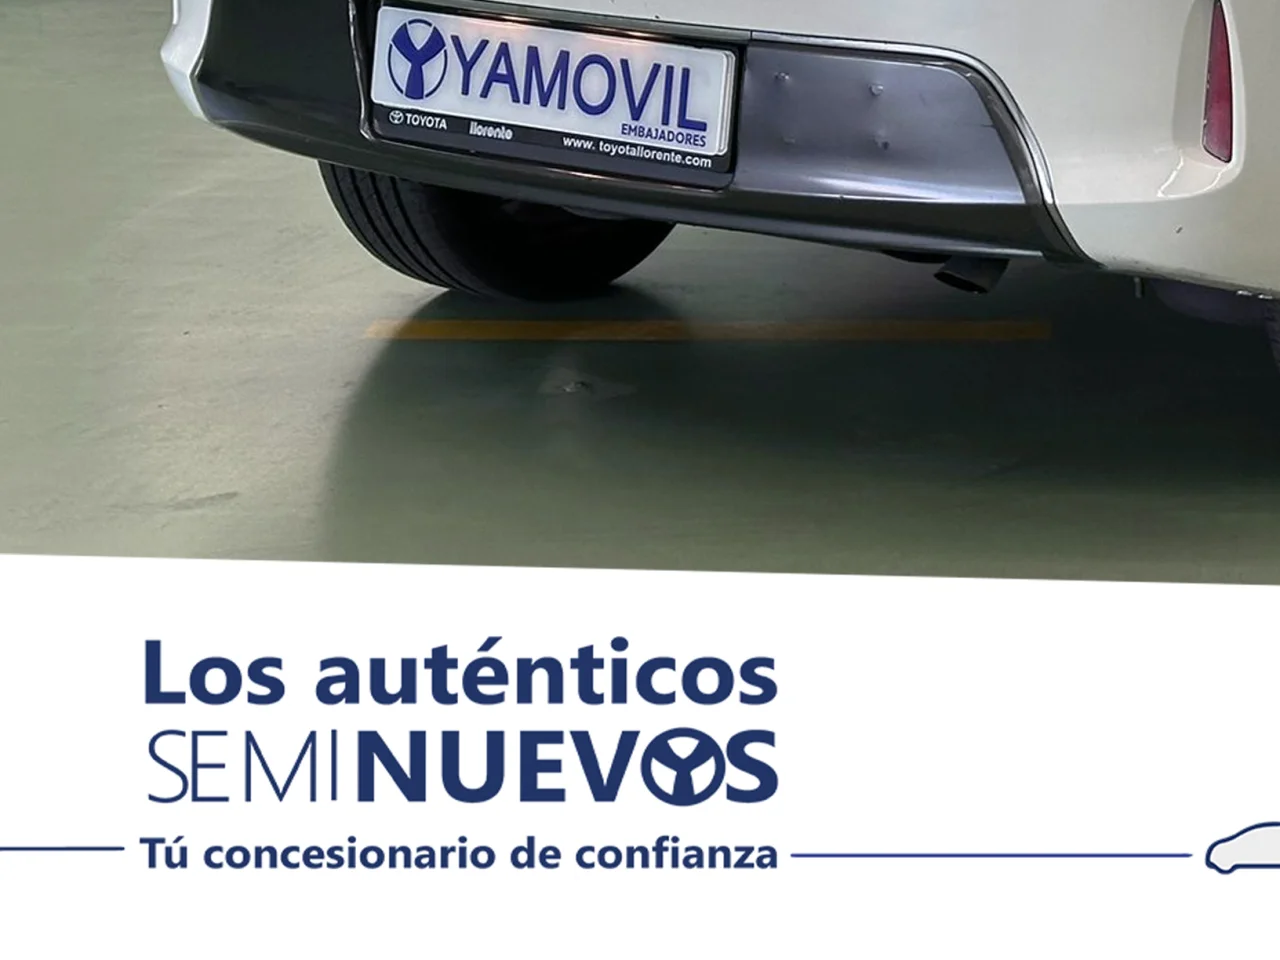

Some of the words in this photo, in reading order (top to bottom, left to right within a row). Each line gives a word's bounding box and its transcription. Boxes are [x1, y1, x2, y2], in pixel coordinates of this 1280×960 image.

[450, 34, 707, 132] YAMOVIL
[405, 112, 448, 131] TOYOTA
[469, 121, 513, 140] llorente
[621, 123, 707, 148] EMBAJADORES
